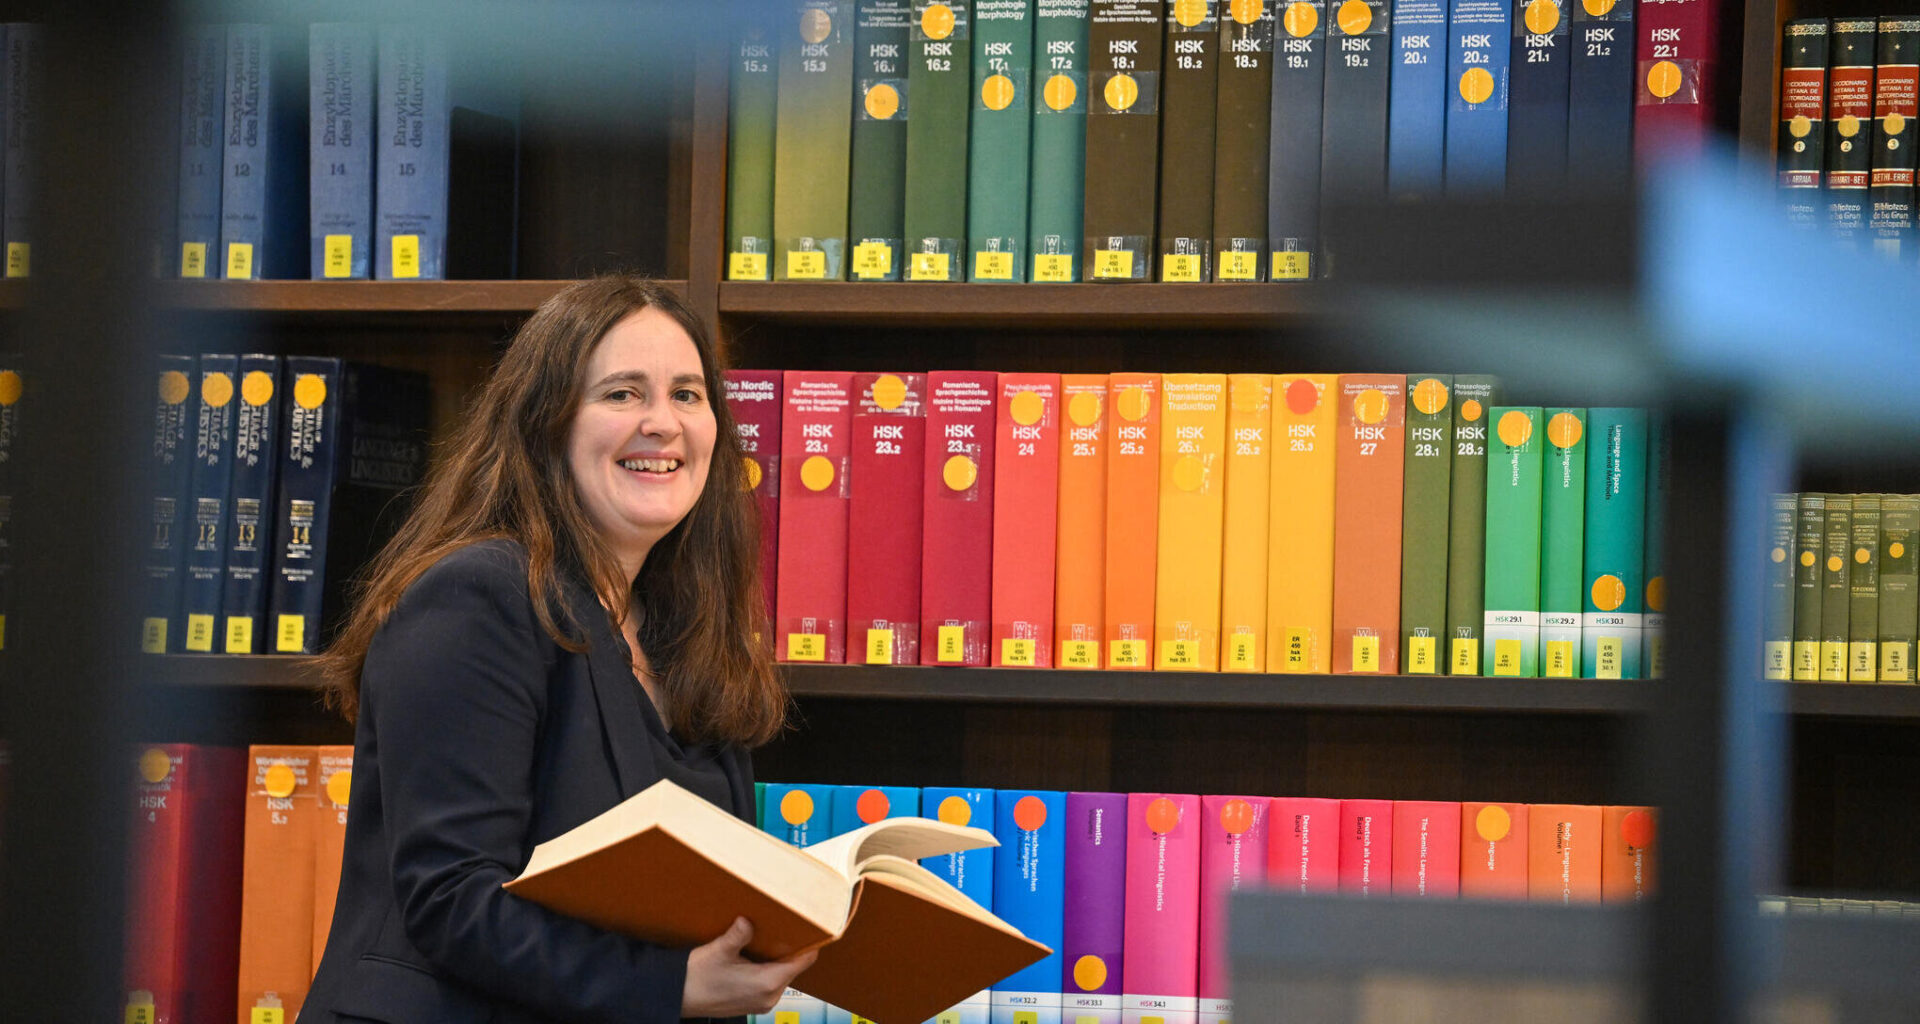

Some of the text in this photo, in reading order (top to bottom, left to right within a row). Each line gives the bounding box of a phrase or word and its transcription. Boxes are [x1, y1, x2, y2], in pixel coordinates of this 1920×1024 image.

[976, 1, 1026, 11] Morphologie
[976, 11, 1025, 20] Morphology
[1038, 8, 1087, 18] Morphology
[1461, 34, 1491, 47] HSK
[1525, 34, 1555, 47] HSK
[1585, 28, 1615, 41] HSK
[1651, 28, 1681, 41] HSK
[1047, 41, 1075, 54] HSK
[1109, 40, 1138, 53] HSK
[1174, 40, 1204, 53] HSK
[1231, 39, 1261, 52] HSK
[1283, 40, 1312, 52] HSK
[1341, 38, 1371, 51] HSK
[1401, 35, 1430, 48] HSK
[801, 43, 829, 57] HSK
[870, 44, 898, 57] HSK
[923, 43, 952, 56] HSK
[984, 42, 1013, 56] HSK
[1587, 43, 1611, 56] 21.2
[1653, 45, 1678, 57] 22.1
[1112, 56, 1135, 69] 18.1
[1176, 56, 1203, 69] 18.2
[1234, 55, 1258, 68] 18.3
[1287, 55, 1309, 68] 19.1
[1344, 54, 1369, 67] 19.2
[1404, 51, 1427, 64] 20.1
[1463, 51, 1489, 63] 20.2
[1527, 50, 1550, 62] 21.1
[803, 60, 827, 72] 15.3
[926, 58, 951, 71] 16.2
[988, 58, 1009, 70] 17.1
[1050, 57, 1073, 69] 17.2
[339, 119, 353, 148] des
[1889, 140, 1897, 148] 3
[233, 163, 250, 177] 12
[330, 163, 346, 176] 14
[399, 163, 416, 176] 15
[741, 380, 774, 391] Nordic
[1163, 380, 1221, 392] Übersetzung
[726, 391, 775, 402] anguages
[1168, 392, 1217, 401] Translation
[1168, 402, 1216, 411] Traduction
[802, 424, 833, 437] HSK
[873, 425, 904, 439] HSK
[944, 424, 975, 437] HSK
[1012, 426, 1041, 439] HSK
[1070, 427, 1098, 440] HSK
[1118, 426, 1147, 439] HSK
[1176, 426, 1204, 439] HSK
[1234, 428, 1263, 441] HSK
[1288, 424, 1316, 437] HSK
[1354, 427, 1385, 440] HSK
[1412, 427, 1443, 440] HSK
[1456, 427, 1486, 440] HSK
[805, 440, 828, 453] 23.1
[875, 441, 901, 454] 23.2
[947, 440, 972, 453] 23.3
[1178, 440, 1200, 453] 26.1
[1290, 439, 1314, 452] 26.3
[1613, 424, 1623, 458] Language
[1018, 443, 1035, 455] 24
[1072, 443, 1096, 456] 25.1
[1120, 442, 1145, 455] 25.2
[1236, 443, 1260, 455] 26.2
[1360, 442, 1377, 455] 27
[1415, 443, 1440, 457] 28.1
[1457, 442, 1484, 456] 28.2
[1511, 449, 1520, 487] Linguistics
[1563, 451, 1571, 488] Linguistics
[1612, 472, 1621, 494] Space
[199, 524, 217, 542] 12
[239, 524, 256, 542] 13
[292, 526, 310, 544] 14
[140, 797, 167, 808] HSK
[267, 798, 295, 810] HSK
[148, 811, 156, 823] 4
[271, 812, 287, 824] 5.2
[1094, 808, 1103, 846] Semantics
[1302, 815, 1310, 844] Deutsch
[1421, 818, 1429, 831] The
[1364, 816, 1372, 847] Deutsch
[1420, 832, 1428, 858] Semitic
[1233, 840, 1241, 876] Historical
[1363, 848, 1371, 858] als
[1562, 822, 1572, 883] Body Language
[957, 855, 966, 889] Sprachen
[1030, 858, 1039, 892] Sprachen
[1156, 836, 1167, 911] Historical Linguistics
